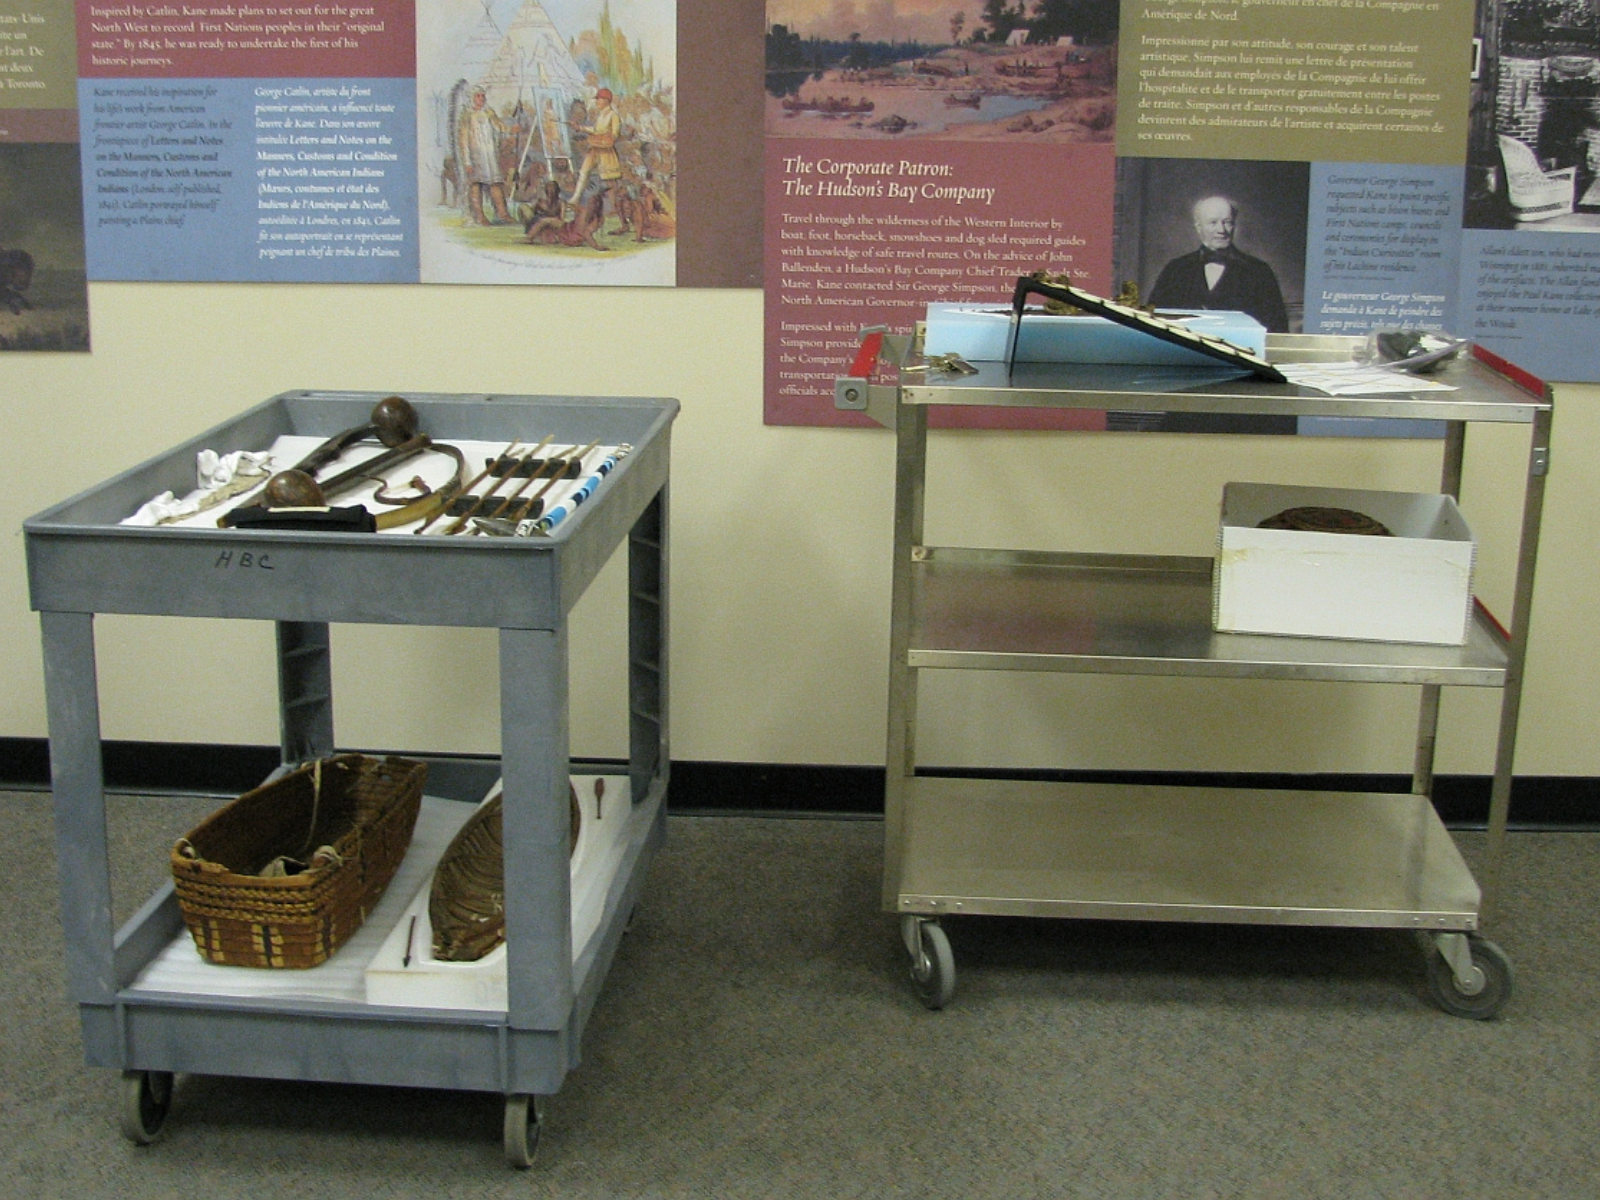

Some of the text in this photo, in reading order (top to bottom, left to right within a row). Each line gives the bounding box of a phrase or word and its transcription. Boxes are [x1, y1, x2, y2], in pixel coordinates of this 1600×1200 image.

[90, 5, 130, 19] Inspired
[132, 5, 144, 18] by
[182, 5, 207, 15] Kane
[210, 5, 236, 15] made
[238, 5, 264, 18] plans
[266, 6, 276, 15] to
[279, 6, 292, 15] set
[294, 6, 312, 15] out
[314, 5, 329, 15] for
[332, 5, 346, 15] the
[349, 6, 374, 18] great
[1194, 10, 1207, 20] de
[92, 22, 121, 32] North
[124, 22, 148, 32] West
[150, 23, 161, 31] to
[164, 22, 194, 31] record
[200, 22, 222, 31] First
[224, 21, 263, 31] Nations
[266, 21, 302, 34] peoples
[304, 22, 314, 31] in
[316, 21, 340, 31] their
[123, 39, 136, 51] By
[164, 39, 176, 48] he
[200, 38, 224, 51] ready
[227, 39, 238, 48] to
[240, 38, 289, 48] undertake
[292, 38, 308, 48] the
[310, 38, 329, 48] first
[332, 38, 343, 48] of
[344, 38, 358, 47] his
[1212, 39, 1229, 49] par
[1296, 42, 1314, 50] son
[1316, 43, 1354, 53] courage
[1369, 44, 1386, 52] son
[1389, 42, 1418, 52] talent
[92, 54, 128, 65] historic
[1194, 52, 1237, 65] Simpson
[1240, 52, 1252, 63] lui
[1255, 54, 1283, 64] remit
[1285, 57, 1303, 65] une
[1306, 54, 1333, 66] lettre
[1335, 56, 1348, 66] de
[1138, 98, 1150, 108] de
[1186, 100, 1229, 112] Simpson
[1232, 103, 1241, 111] et
[1285, 103, 1347, 114] responsables
[1350, 104, 1363, 114] de
[1365, 104, 1373, 114] la
[1376, 105, 1433, 118] Compagnie
[783, 155, 953, 180] The Corporate Patron:
[783, 178, 996, 204] The Hudson's Bay Company
[782, 213, 1064, 232] Travel through the wilderness of the Western Interior by
[889, 231, 942, 242] snowshoes
[945, 232, 963, 242] and
[966, 232, 985, 246] dog
[988, 233, 1007, 243] sled
[1009, 233, 1052, 247] required
[1054, 234, 1086, 247] guides
[781, 246, 804, 257] with
[806, 246, 859, 260] knowledge
[862, 247, 874, 258] of
[875, 248, 894, 258] safe
[897, 248, 924, 259] travel
[964, 249, 980, 260] On
[984, 249, 1000, 260] the
[1002, 250, 1033, 261] advice
[1036, 250, 1048, 261] of
[1049, 251, 1072, 264] John
[894, 264, 912, 277] Bay
[914, 264, 963, 278] Company
[966, 265, 995, 276] Chief
[998, 266, 1030, 276] Trader
[817, 278, 842, 289] Kane
[844, 279, 893, 290] contacted
[896, 280, 910, 290] Sir
[913, 280, 949, 294] George
[781, 296, 812, 306] North
[816, 296, 863, 306] American
[781, 321, 832, 332] Impressed
[834, 322, 856, 332] with
[780, 338, 824, 349] Simpson
[780, 353, 796, 363] the
[780, 384, 818, 396] officials
[214, 551, 274, 570] HBC
